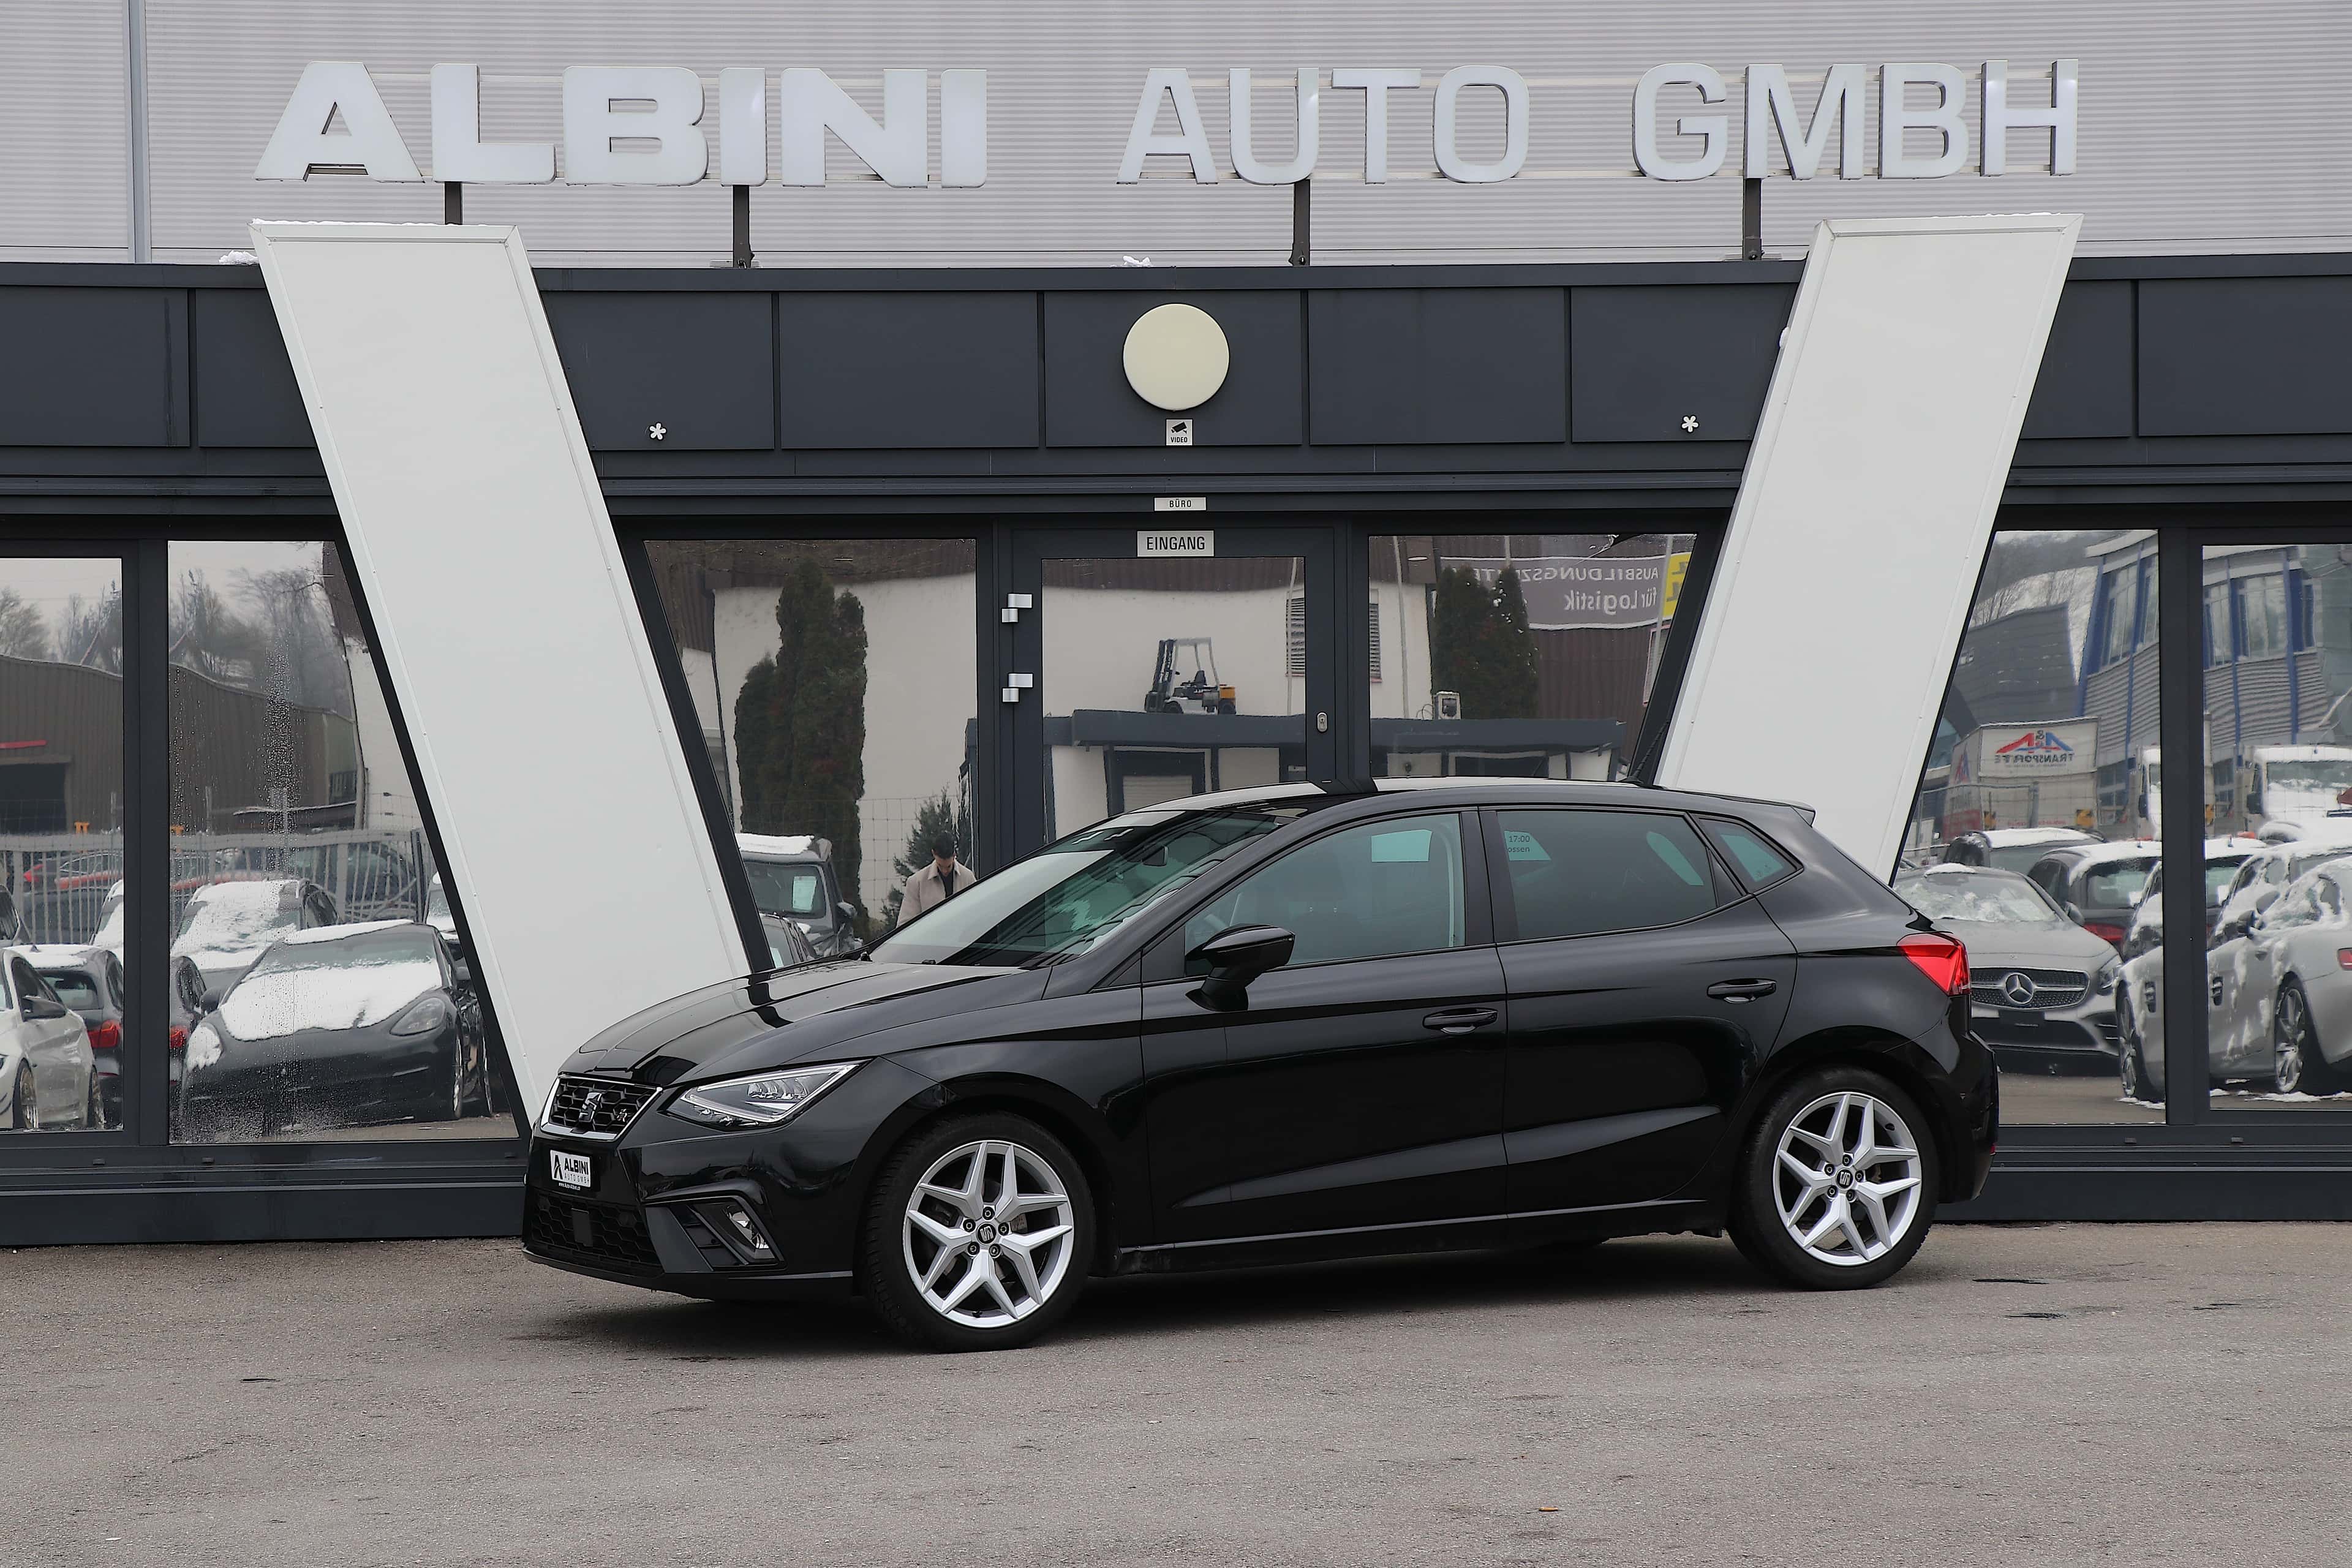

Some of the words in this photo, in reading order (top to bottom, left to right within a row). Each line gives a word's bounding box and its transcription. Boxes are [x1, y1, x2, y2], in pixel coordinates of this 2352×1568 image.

[254, 61, 987, 189] ALBINI
[1116, 65, 1531, 186] AUTO
[1632, 58, 2079, 181] GMBH
[1169, 499, 1191, 507] BÜRO
[1147, 537, 1205, 550] EINGANG
[564, 1158, 589, 1175] ALBINI
[564, 1172, 576, 1182] AUTO
